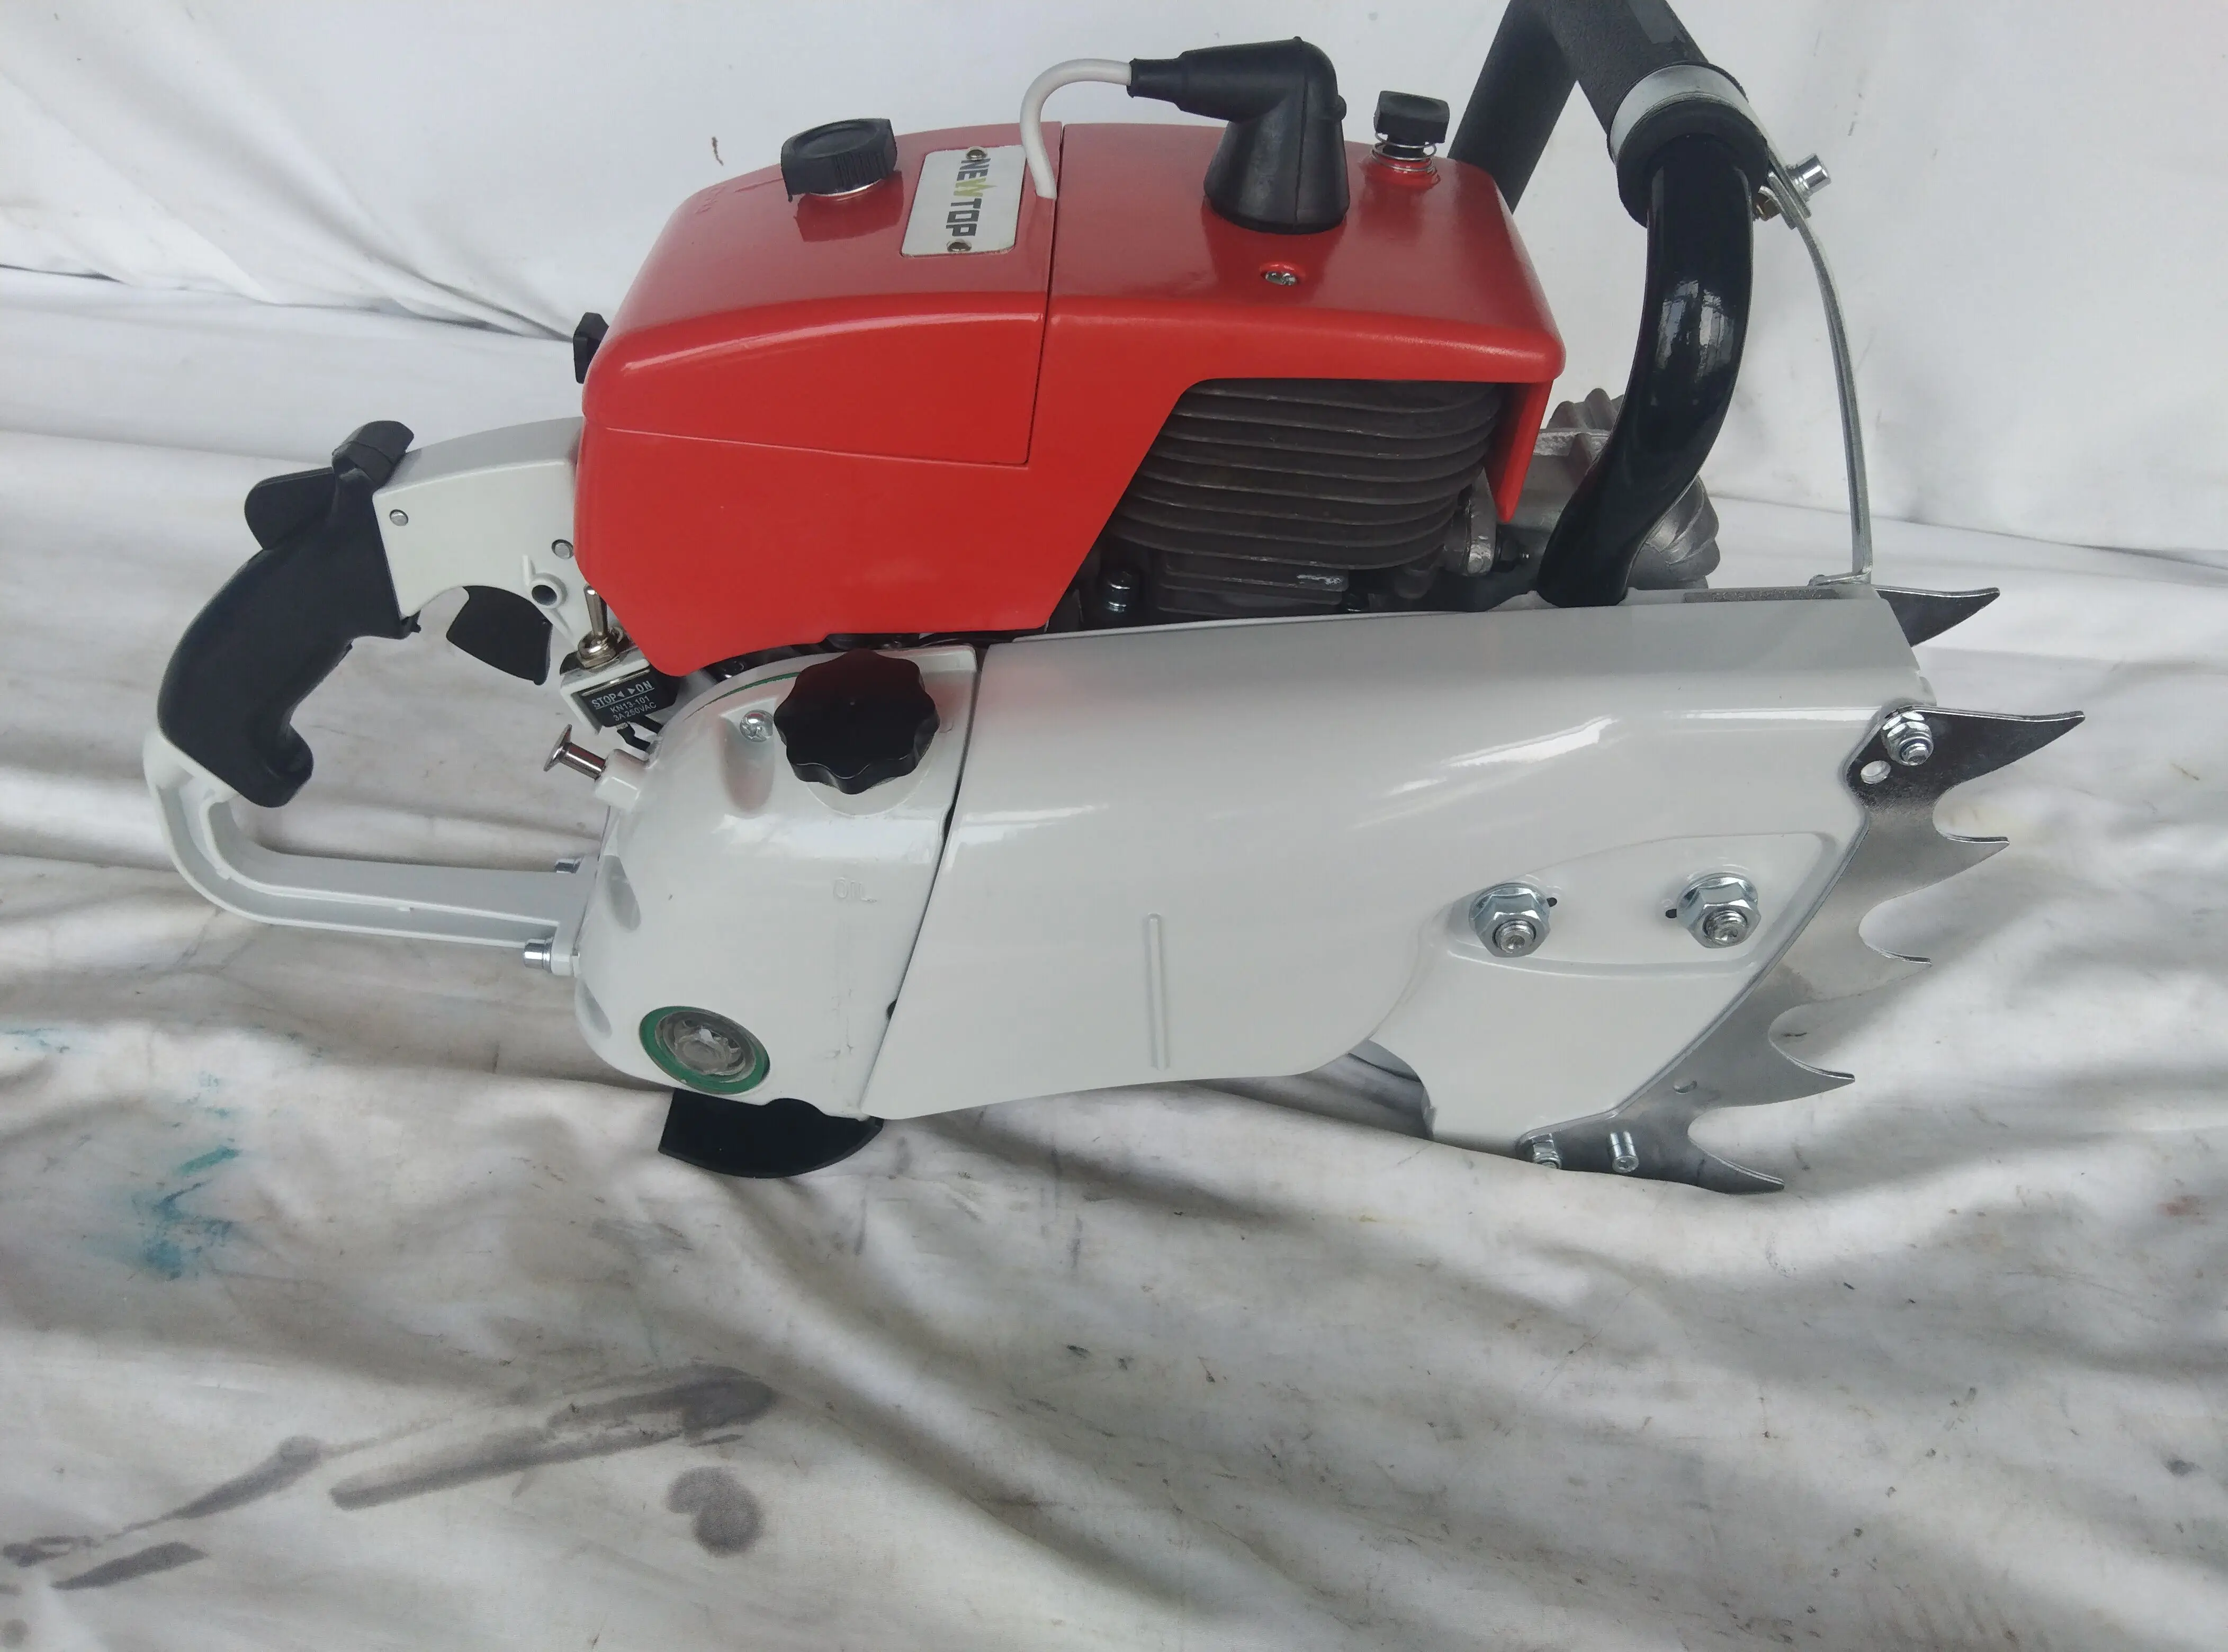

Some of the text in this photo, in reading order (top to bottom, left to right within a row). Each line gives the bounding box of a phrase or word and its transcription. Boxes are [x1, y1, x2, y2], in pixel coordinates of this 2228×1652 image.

[945, 158, 996, 237] NEWTOP
[591, 680, 653, 708] STOP ON
[610, 695, 650, 714] KN13-101
[627, 702, 657, 717] 250VAC
[833, 876, 877, 903] OIL
